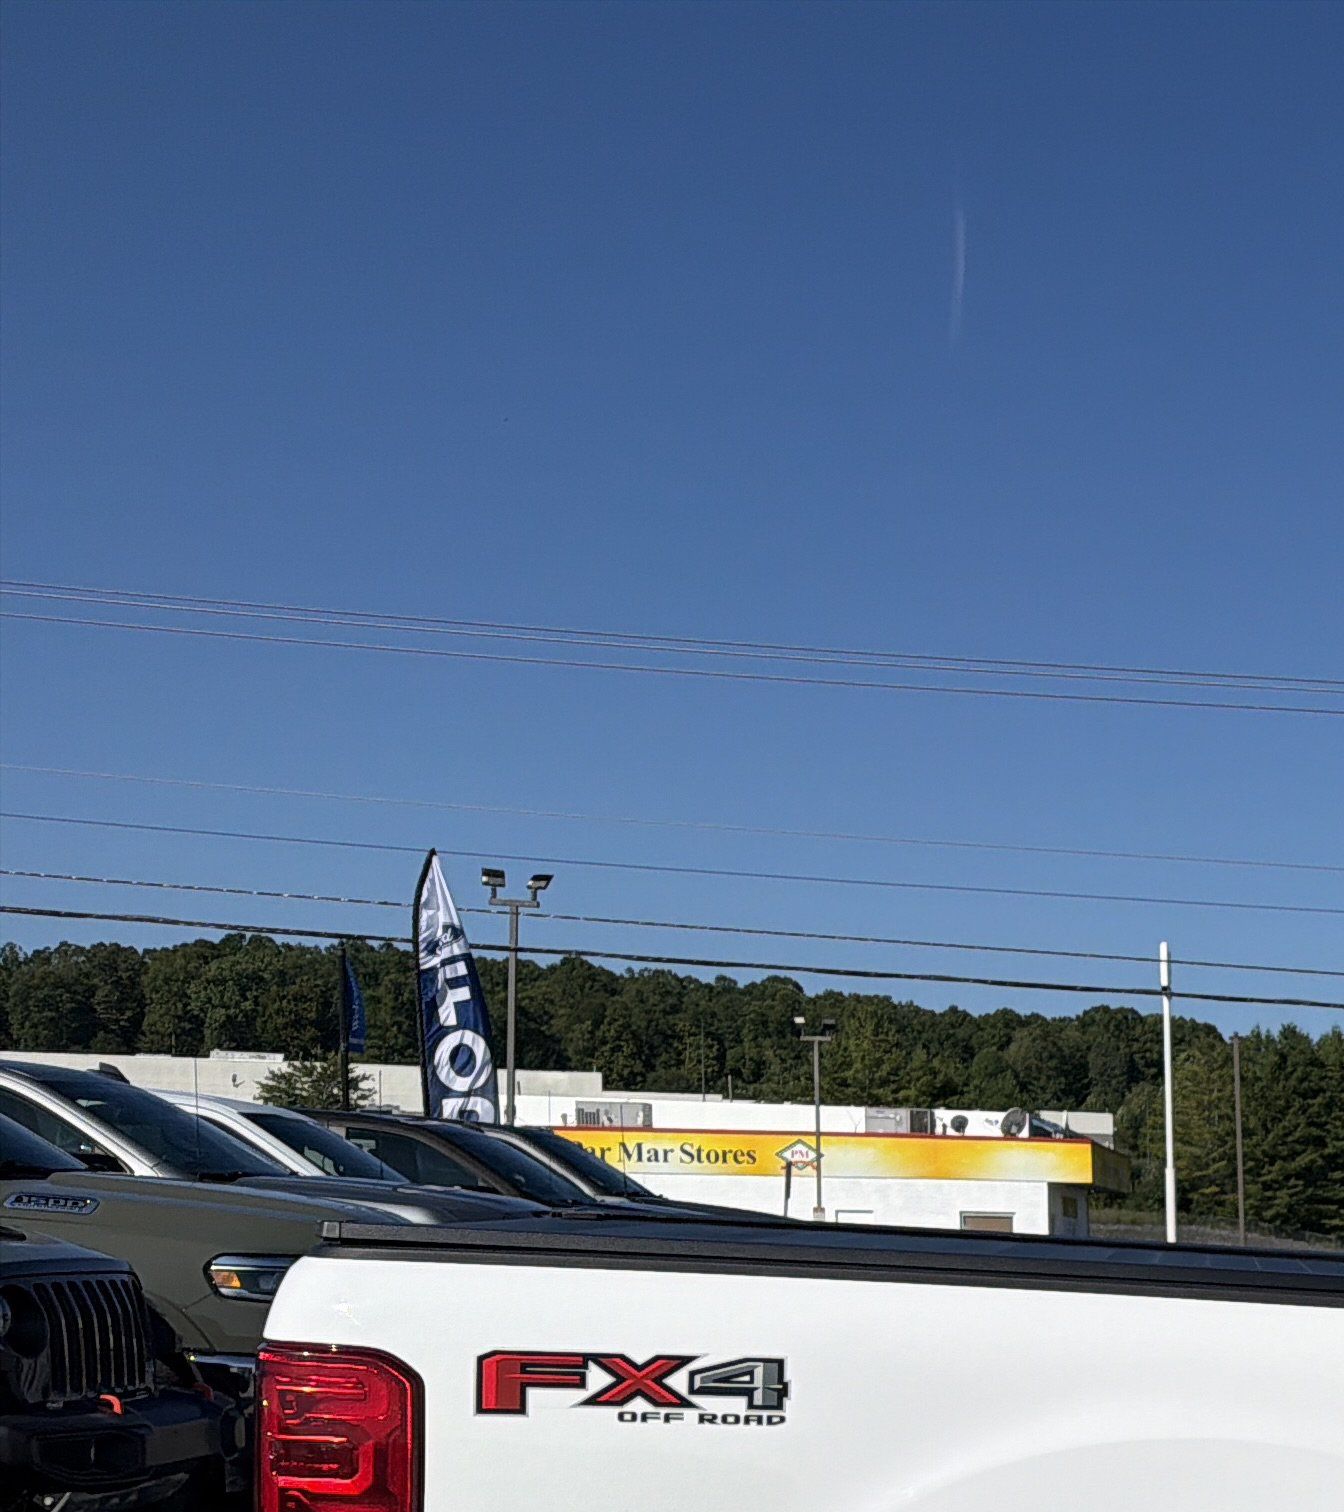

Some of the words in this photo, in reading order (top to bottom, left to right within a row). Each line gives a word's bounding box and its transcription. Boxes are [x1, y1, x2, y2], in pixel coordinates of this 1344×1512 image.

[617, 1142, 675, 1164] Mar
[679, 1142, 757, 1166] Stores
[474, 1349, 792, 1418] FX4
[617, 1410, 685, 1424] OFF
[698, 1412, 786, 1426] ROAD
